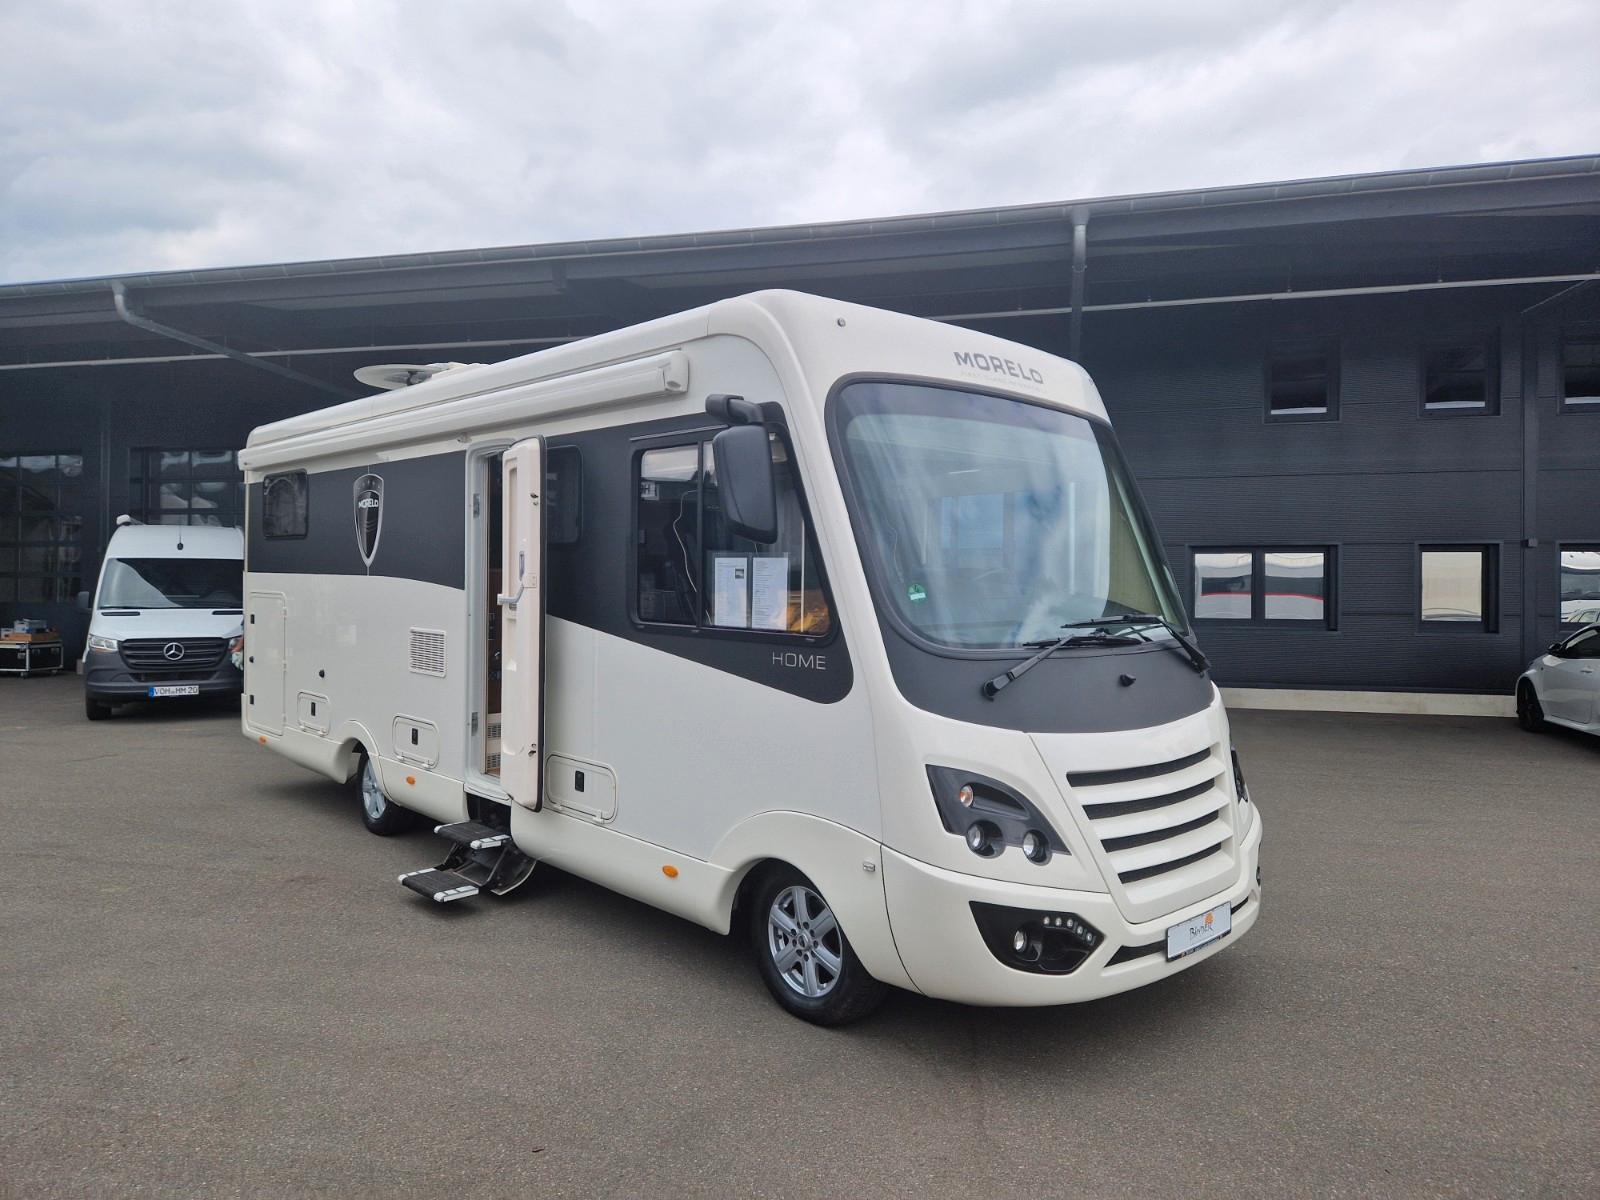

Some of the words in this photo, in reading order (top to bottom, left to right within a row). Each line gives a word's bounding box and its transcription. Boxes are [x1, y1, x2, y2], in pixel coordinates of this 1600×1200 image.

[953, 351, 1044, 384] MORELO
[358, 498, 379, 508] MORELO
[772, 651, 826, 670] HOME
